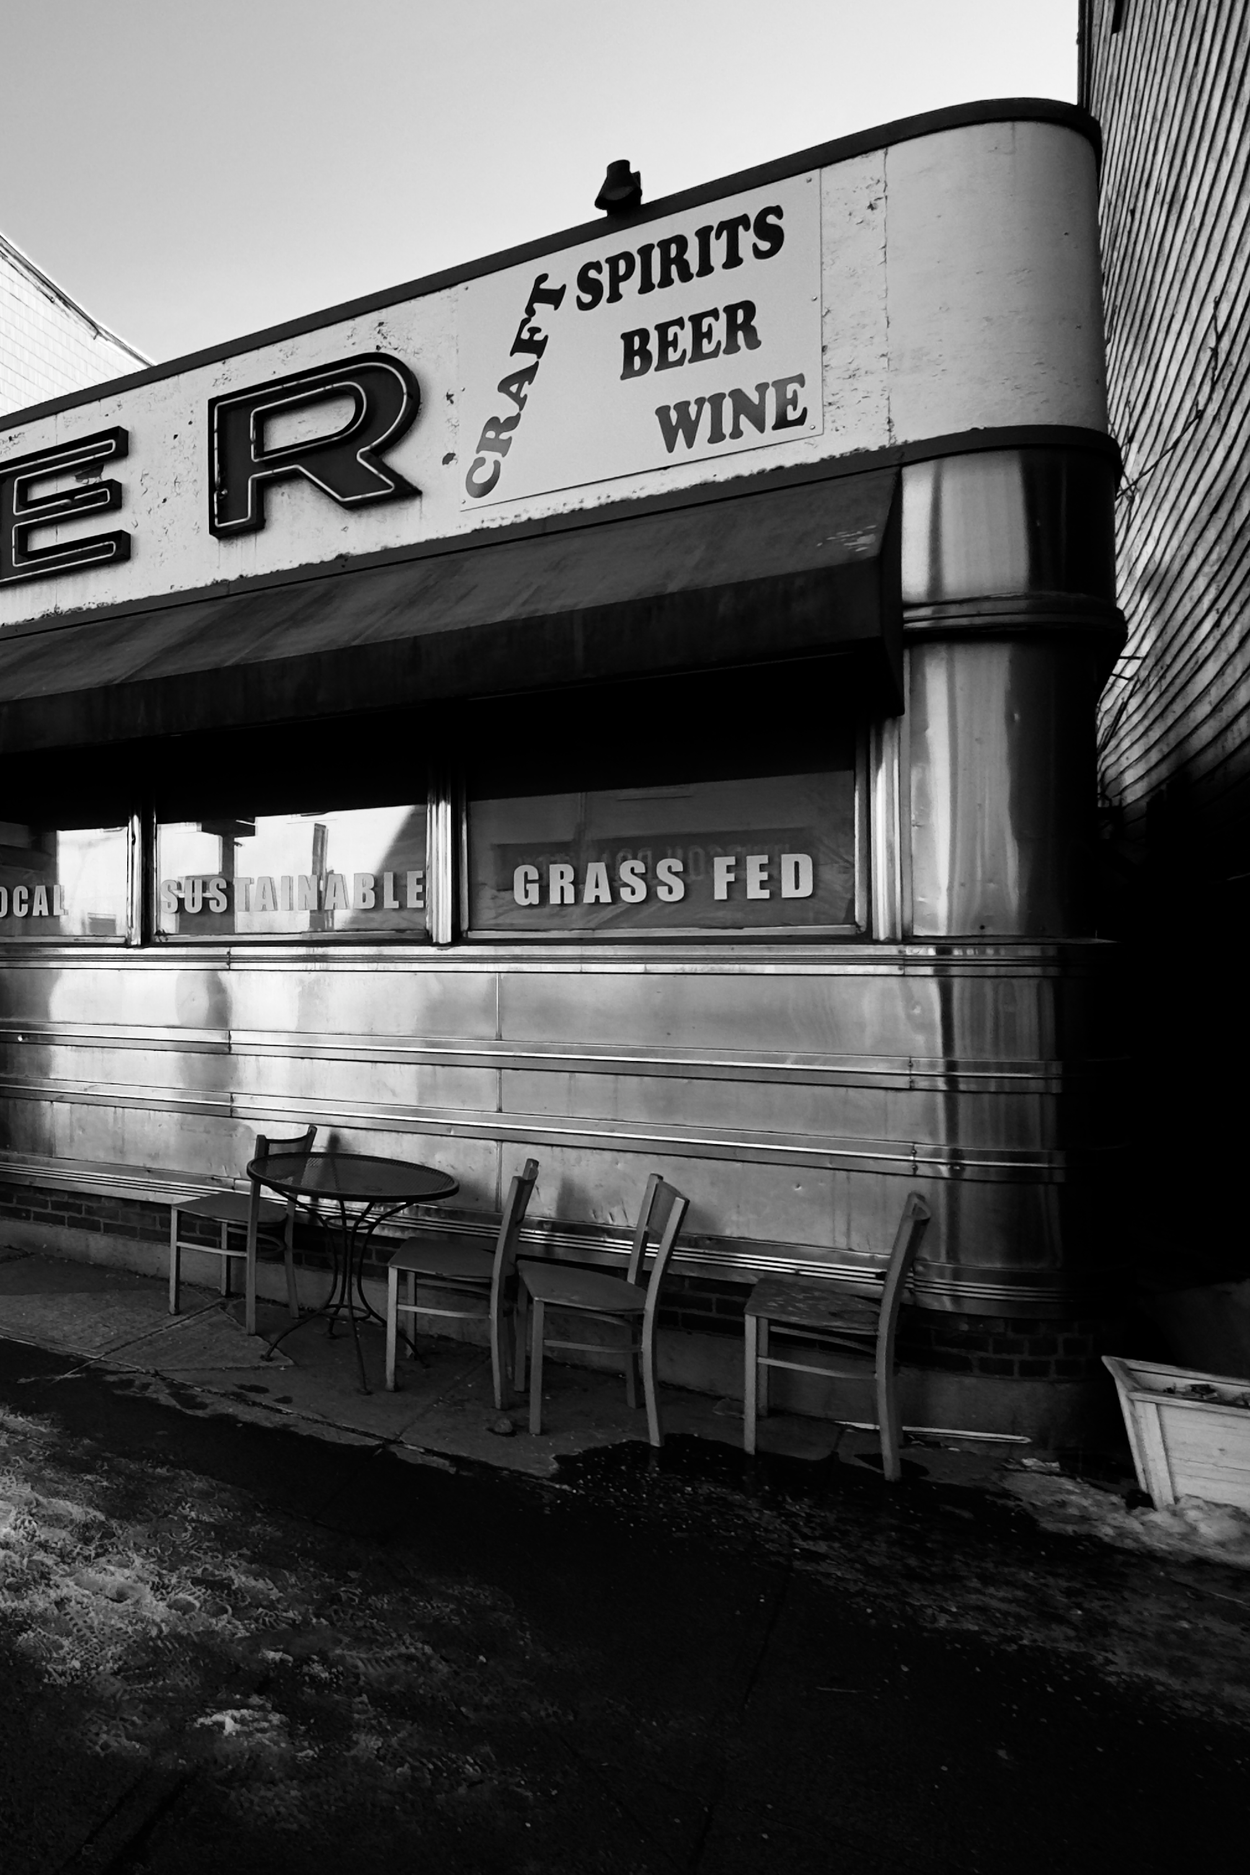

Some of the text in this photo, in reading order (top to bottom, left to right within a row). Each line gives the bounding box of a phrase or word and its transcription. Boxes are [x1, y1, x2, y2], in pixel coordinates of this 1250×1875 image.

[575, 204, 785, 311] SPIRITS
[619, 299, 762, 380] BEER
[465, 272, 567, 499] CRAFT
[654, 372, 808, 454] WINE
[159, 870, 426, 914] SUSTAINABLE
[513, 857, 686, 907] GRASS
[713, 852, 814, 901] FED
